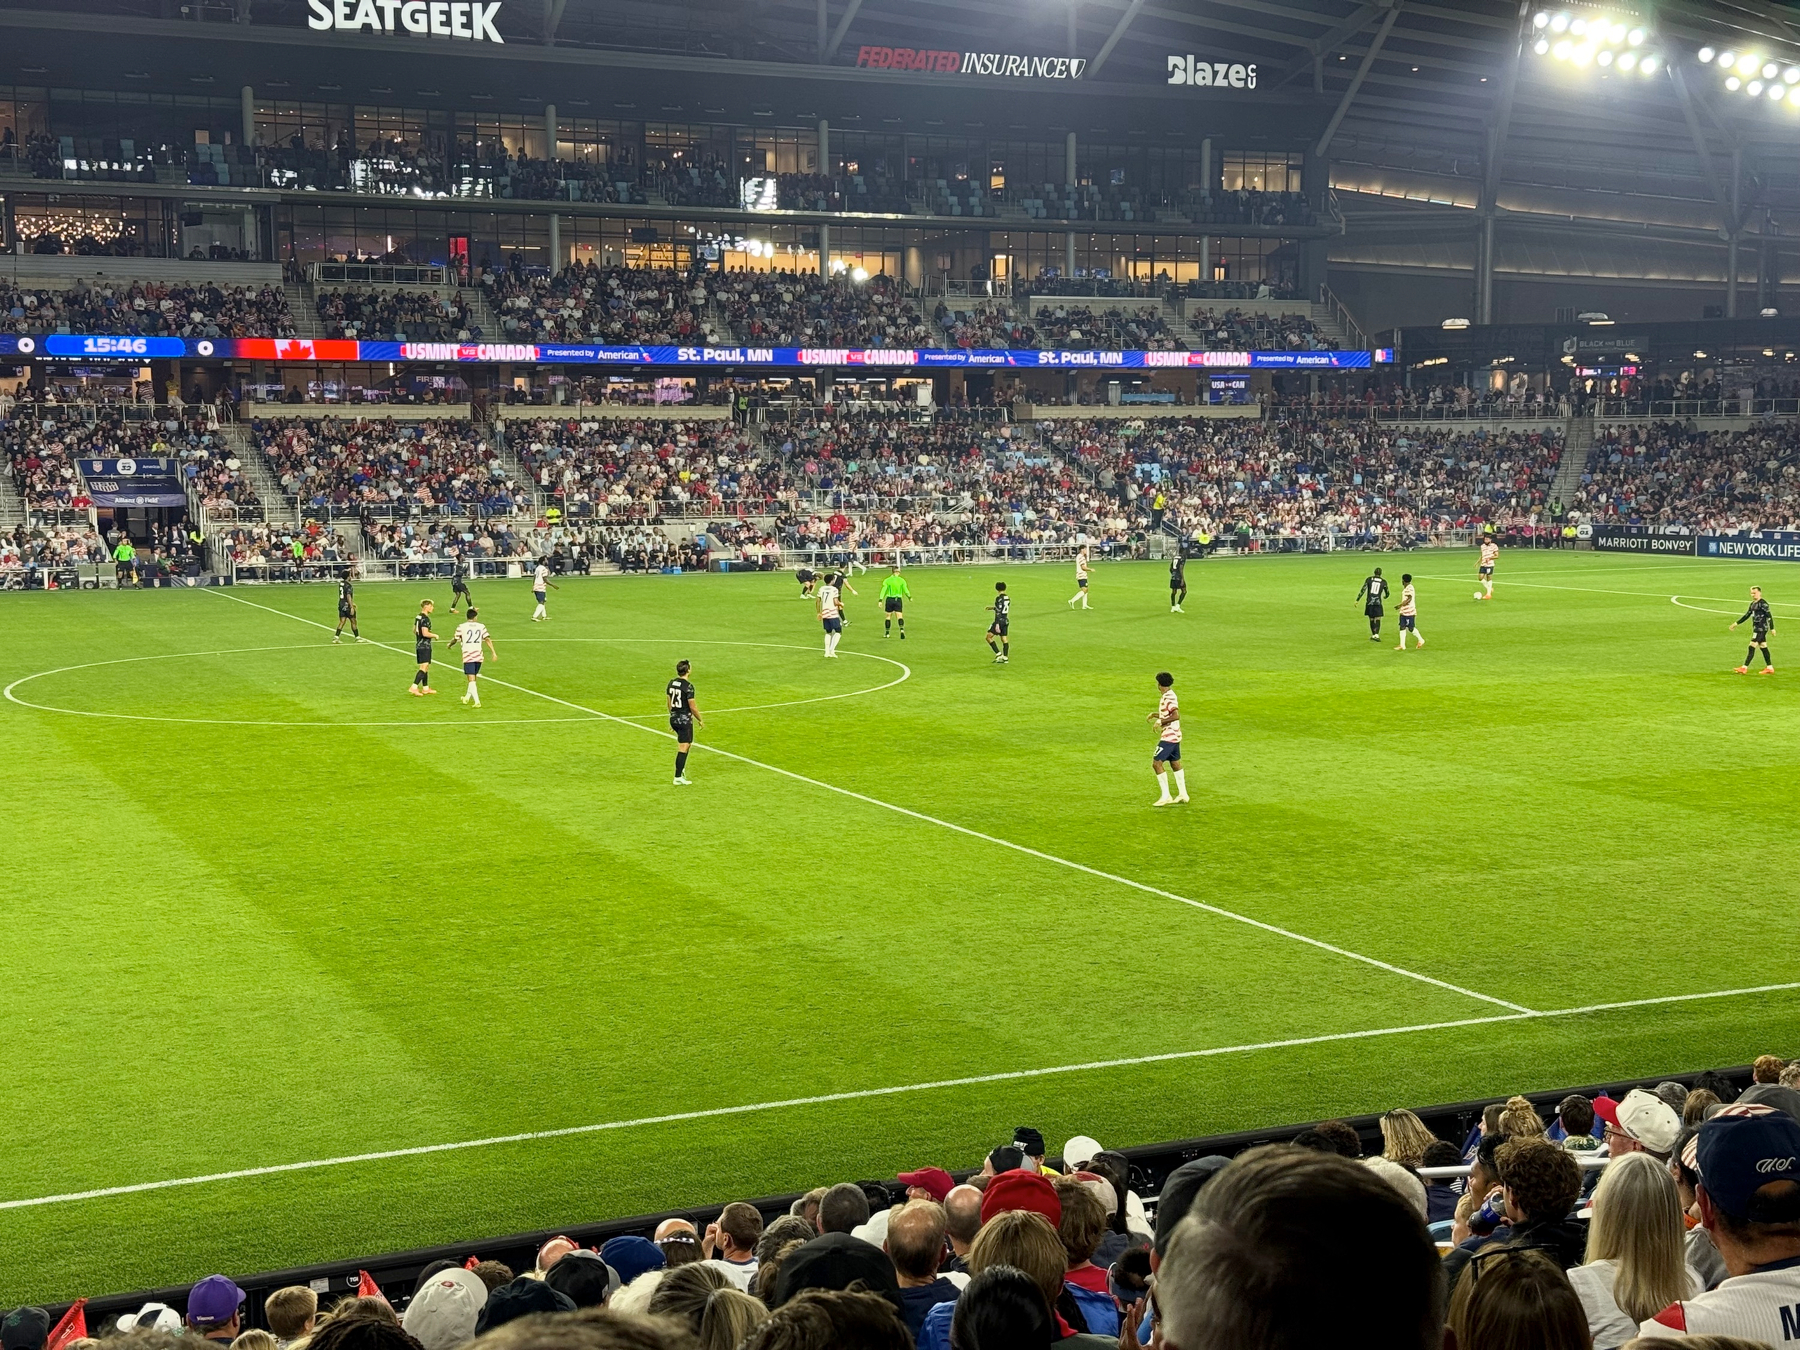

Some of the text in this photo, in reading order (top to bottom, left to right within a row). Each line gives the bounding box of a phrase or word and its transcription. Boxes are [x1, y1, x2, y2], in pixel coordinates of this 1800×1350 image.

[308, 0, 505, 44] SEATGEEK
[856, 45, 1069, 79] FEDERATED INSURANCE
[1167, 54, 1247, 88] Blaze
[84, 338, 147, 353] 15:46
[1580, 340, 1603, 348] BLACK
[1616, 339, 1636, 347] BLUE
[405, 343, 460, 360] USMNT
[477, 343, 536, 361] CANADA
[547, 349, 594, 358] Presented by
[598, 350, 639, 360] American
[677, 348, 773, 363] St. Paul, MN
[801, 349, 849, 365] USMNT
[863, 349, 915, 365] CANADA
[924, 353, 966, 362] Presented by
[968, 354, 1005, 364] American
[1038, 352, 1123, 365] St. Paul, MN
[1148, 351, 1190, 366] USMNT
[1203, 351, 1249, 366] CANADA
[1286, 355, 1294, 363] by
[1296, 355, 1329, 365] American
[1211, 380, 1245, 389] USA CAN
[1598, 536, 1649, 550] MARRIOTT
[1651, 538, 1692, 551] BONVOY
[1719, 541, 1746, 556] NEW
[1747, 543, 1776, 557] YORK
[1777, 543, 1800, 558] LIFE
[1371, 581, 1381, 595] 10
[822, 591, 830, 604] 17
[466, 629, 482, 644] 22
[669, 687, 682, 708] 23
[1756, 1156, 1796, 1173] U.S.
